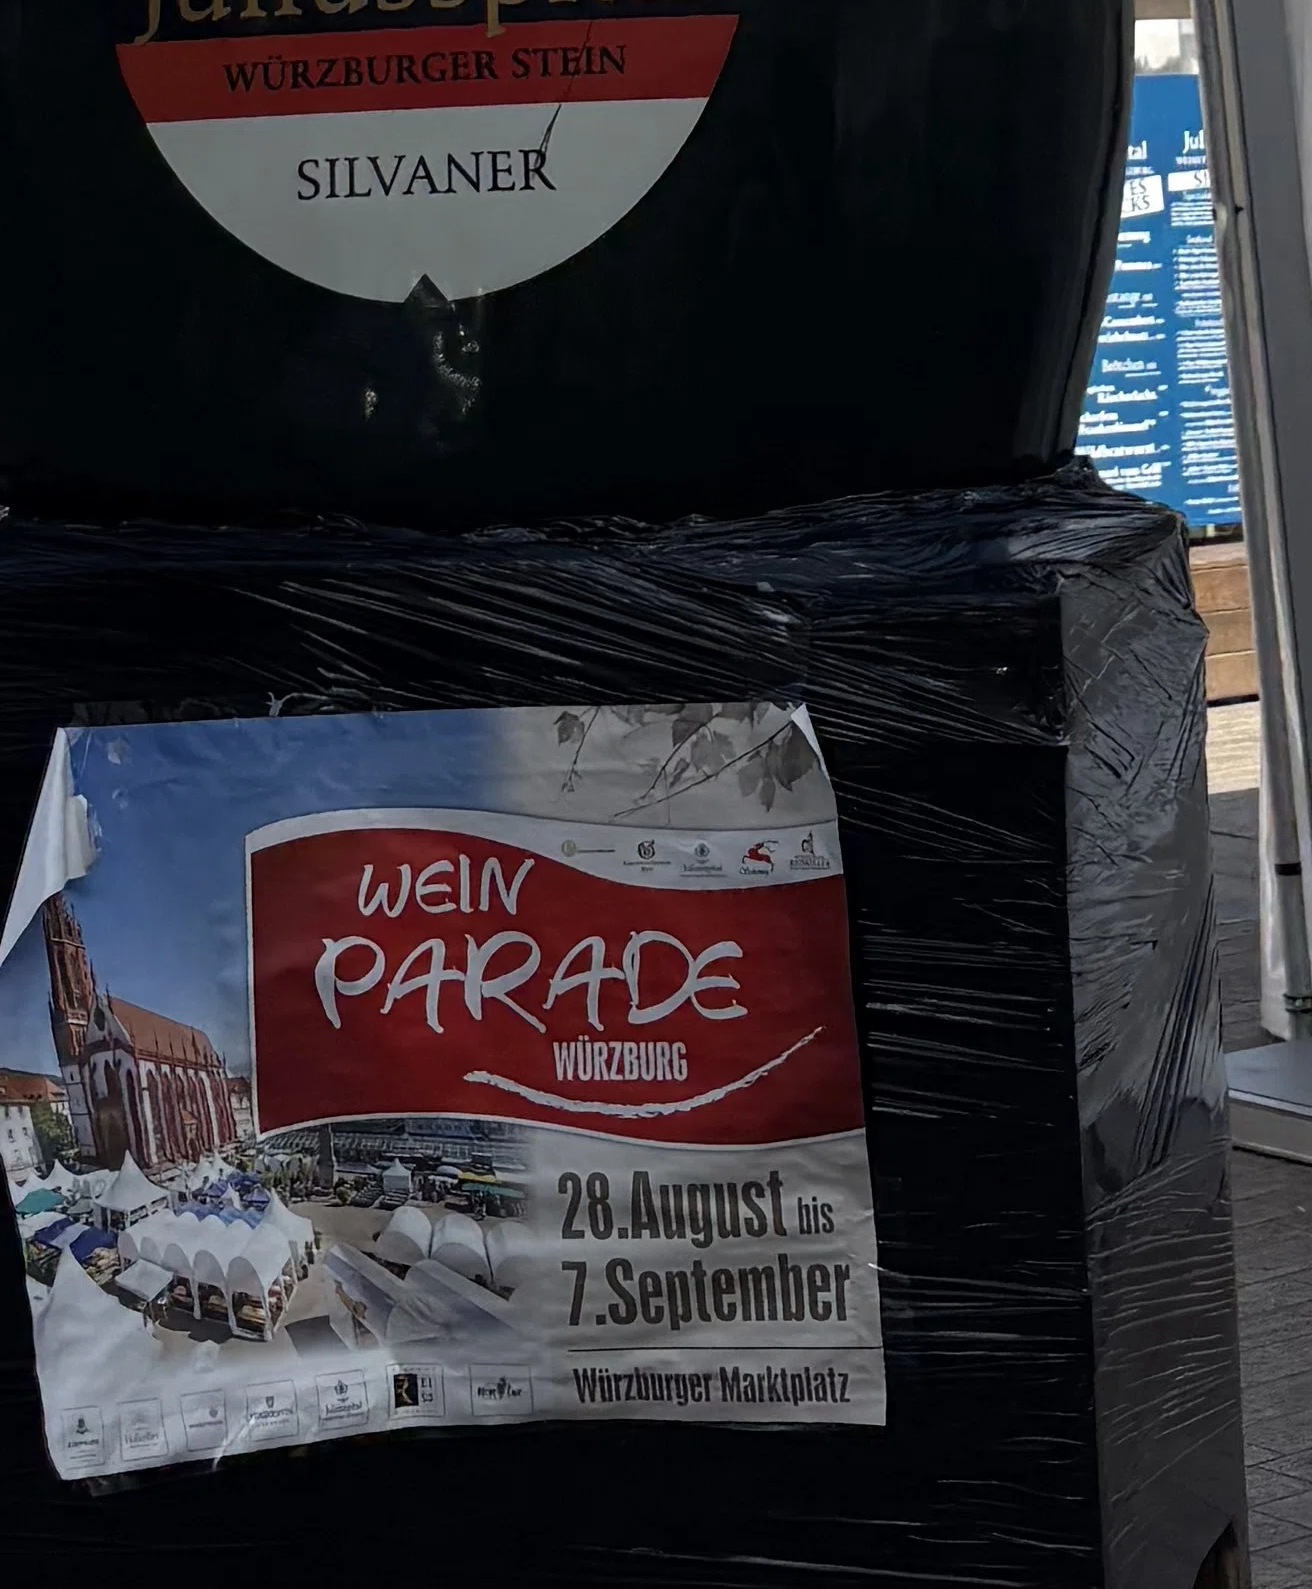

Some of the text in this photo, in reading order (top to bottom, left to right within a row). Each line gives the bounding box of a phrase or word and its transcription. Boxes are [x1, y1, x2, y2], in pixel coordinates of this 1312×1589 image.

[222, 44, 627, 93] WÜRZBURGER STEIN
[296, 148, 557, 201] SILVANER
[356, 853, 536, 918] WEIN
[314, 930, 748, 1033] PARADE
[553, 1035, 688, 1081] WÜRZBURG
[795, 1196, 836, 1236] bis
[572, 1366, 714, 1407] Würzburger
[718, 1365, 851, 1407] Marktplatz
